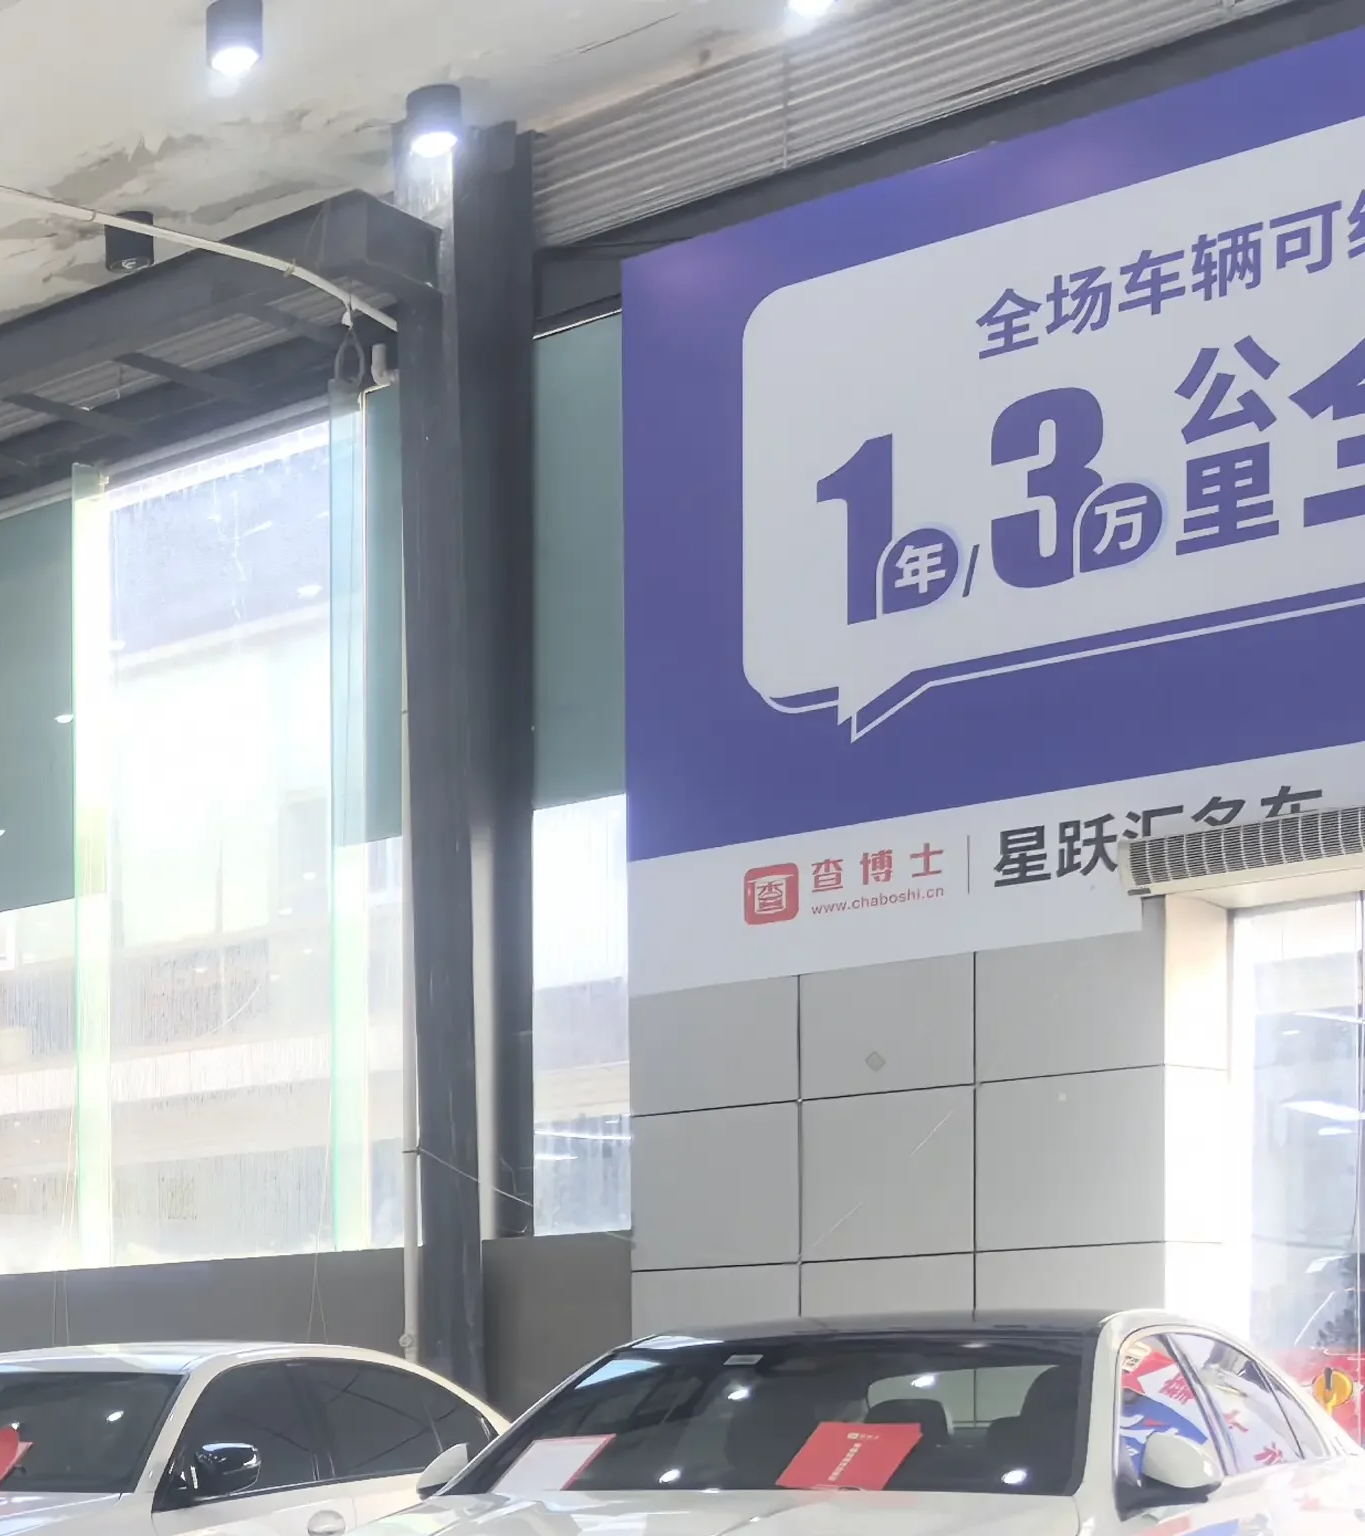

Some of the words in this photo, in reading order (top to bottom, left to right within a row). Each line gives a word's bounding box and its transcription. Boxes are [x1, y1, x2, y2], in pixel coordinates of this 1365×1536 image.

[975, 189, 1365, 359] 全场车辆可
[811, 842, 945, 893] 查博士
[811, 886, 945, 915] www.chaboshi.cn
